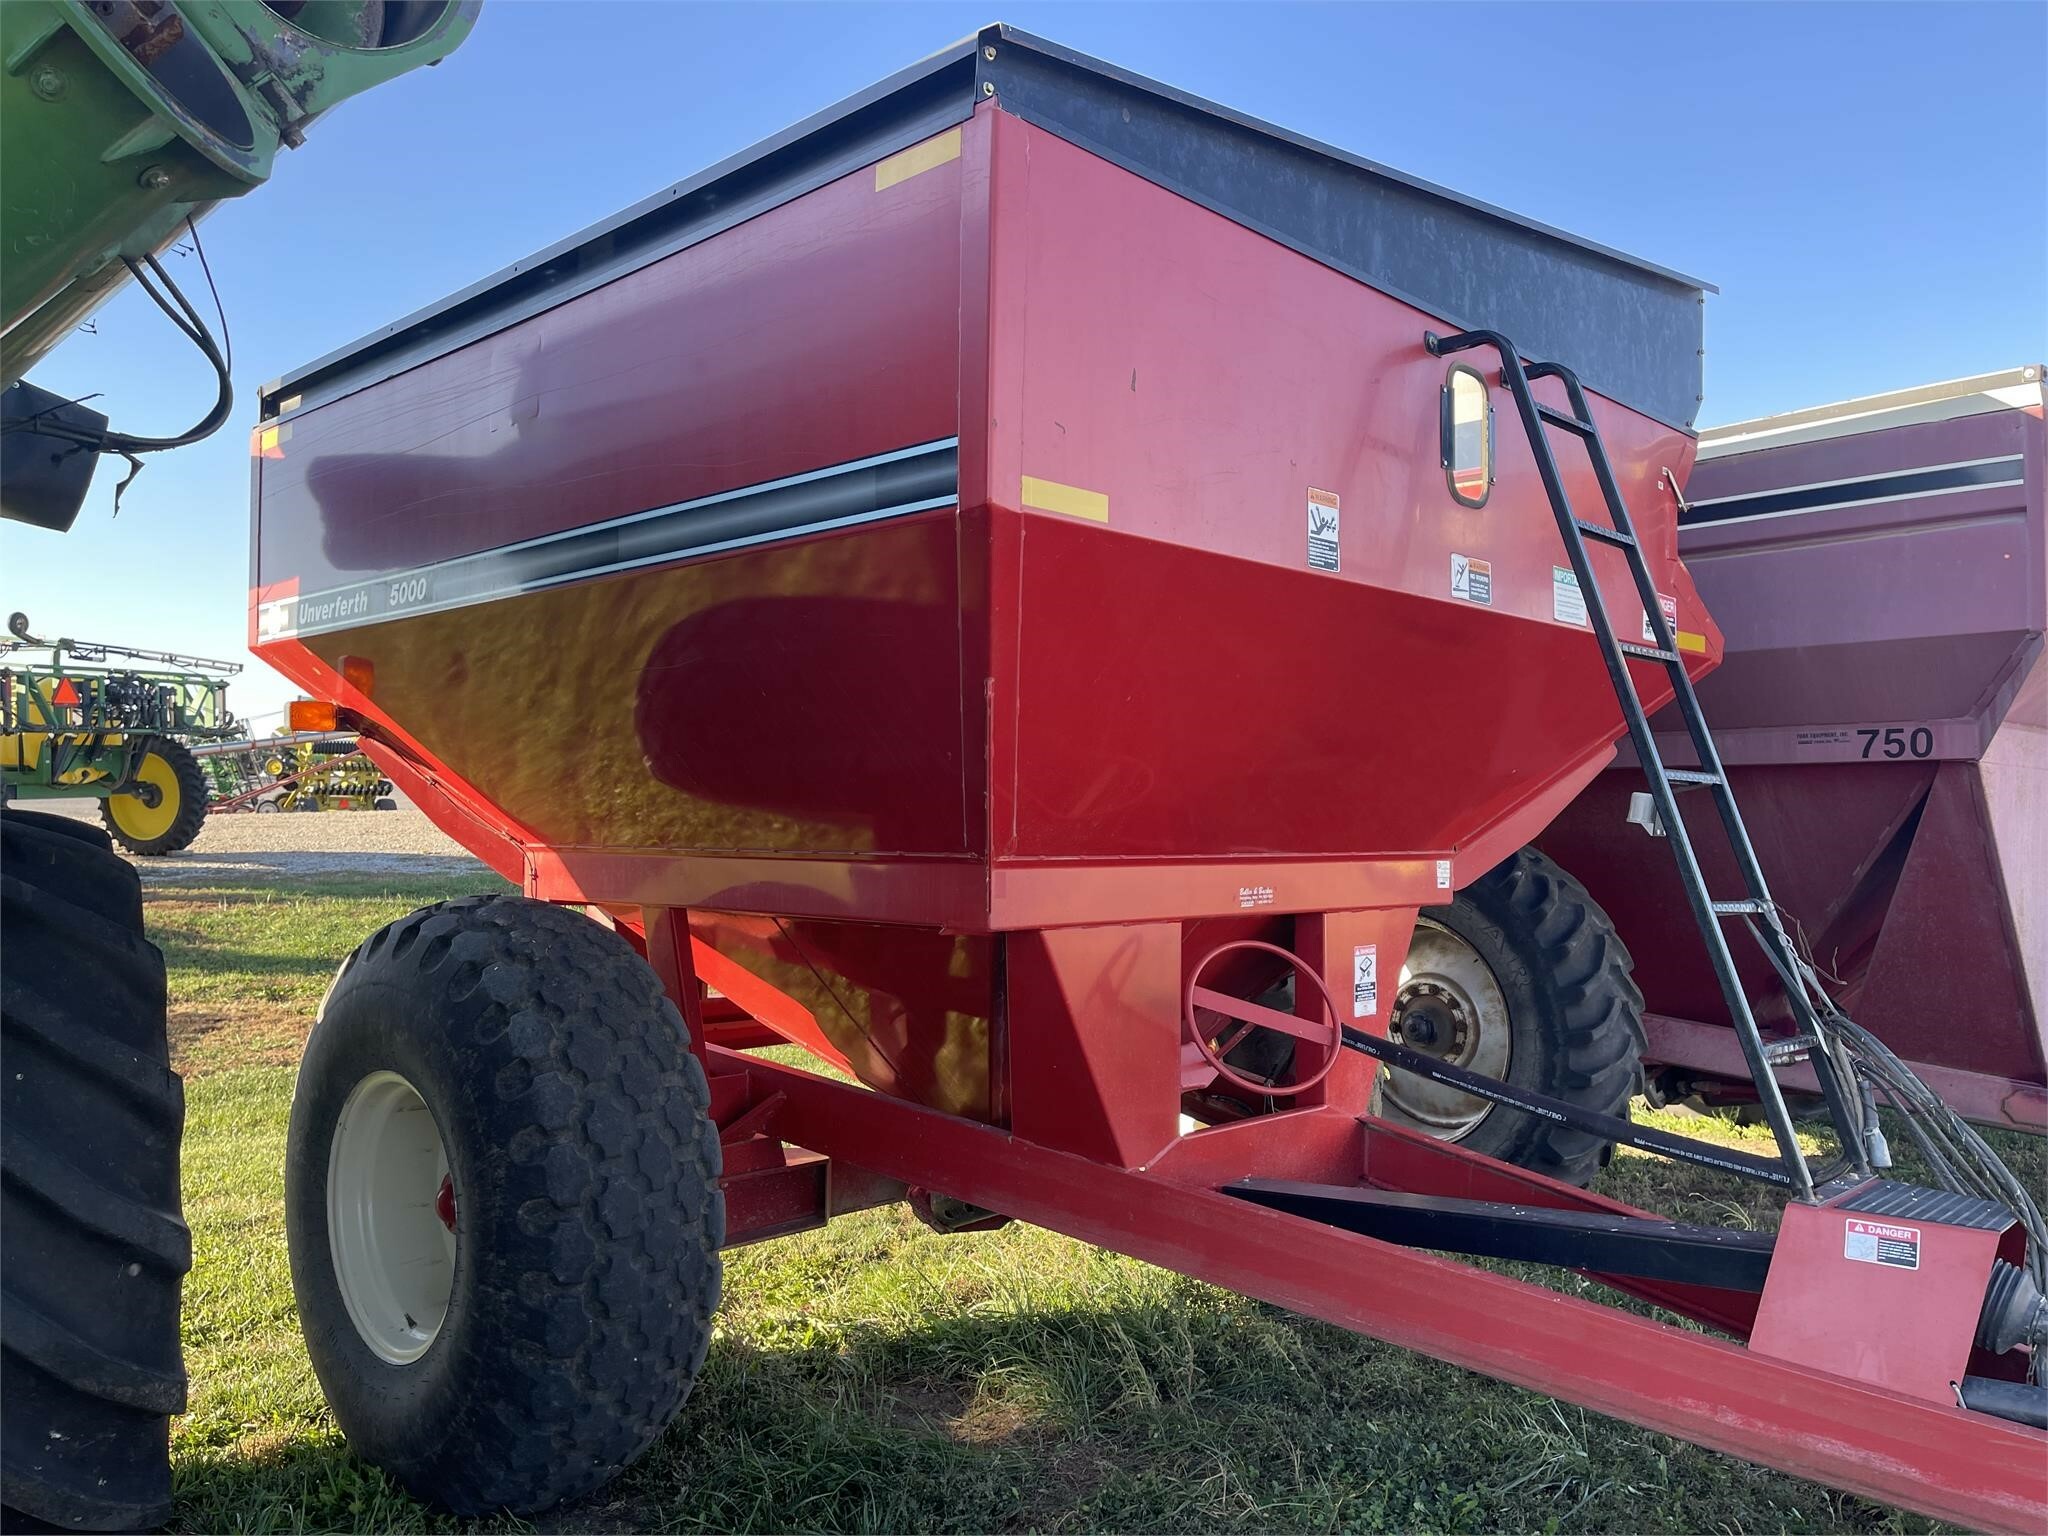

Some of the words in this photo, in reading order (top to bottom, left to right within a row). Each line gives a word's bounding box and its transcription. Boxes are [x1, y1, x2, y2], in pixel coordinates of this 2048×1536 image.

[1554, 569, 1579, 587] IMPORTA
[300, 591, 367, 624] Unverferth
[390, 578, 426, 605] 5000
[1857, 727, 1933, 758] 750
[1868, 1226, 1911, 1239] DANGER
